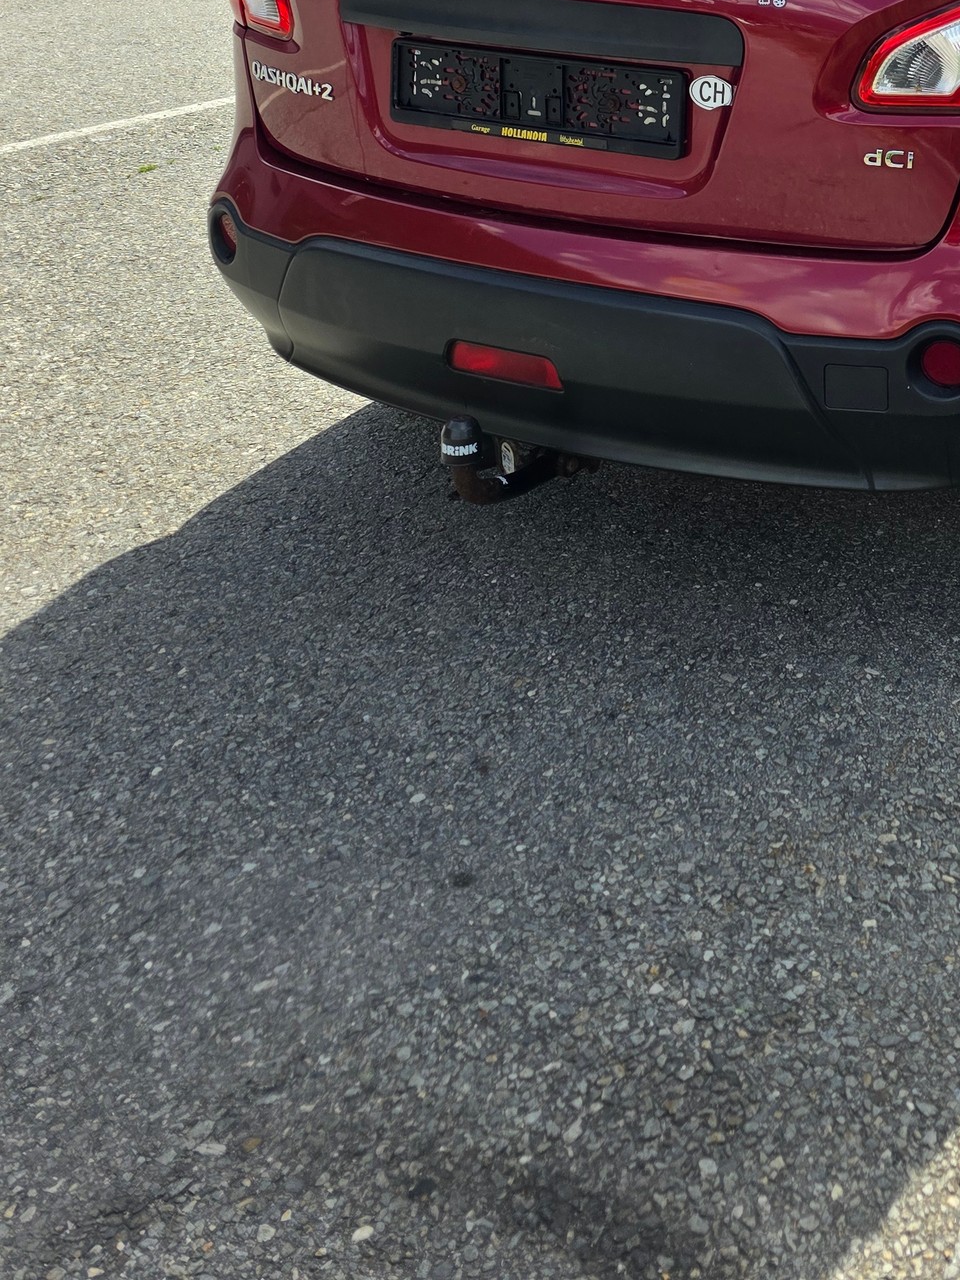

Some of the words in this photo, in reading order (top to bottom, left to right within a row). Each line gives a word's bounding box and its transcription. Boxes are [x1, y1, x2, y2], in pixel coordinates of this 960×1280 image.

[699, 80, 725, 104] CH
[471, 124, 490, 134] Garage
[501, 127, 547, 142] HOLLANDIA
[863, 149, 914, 169] dCi
